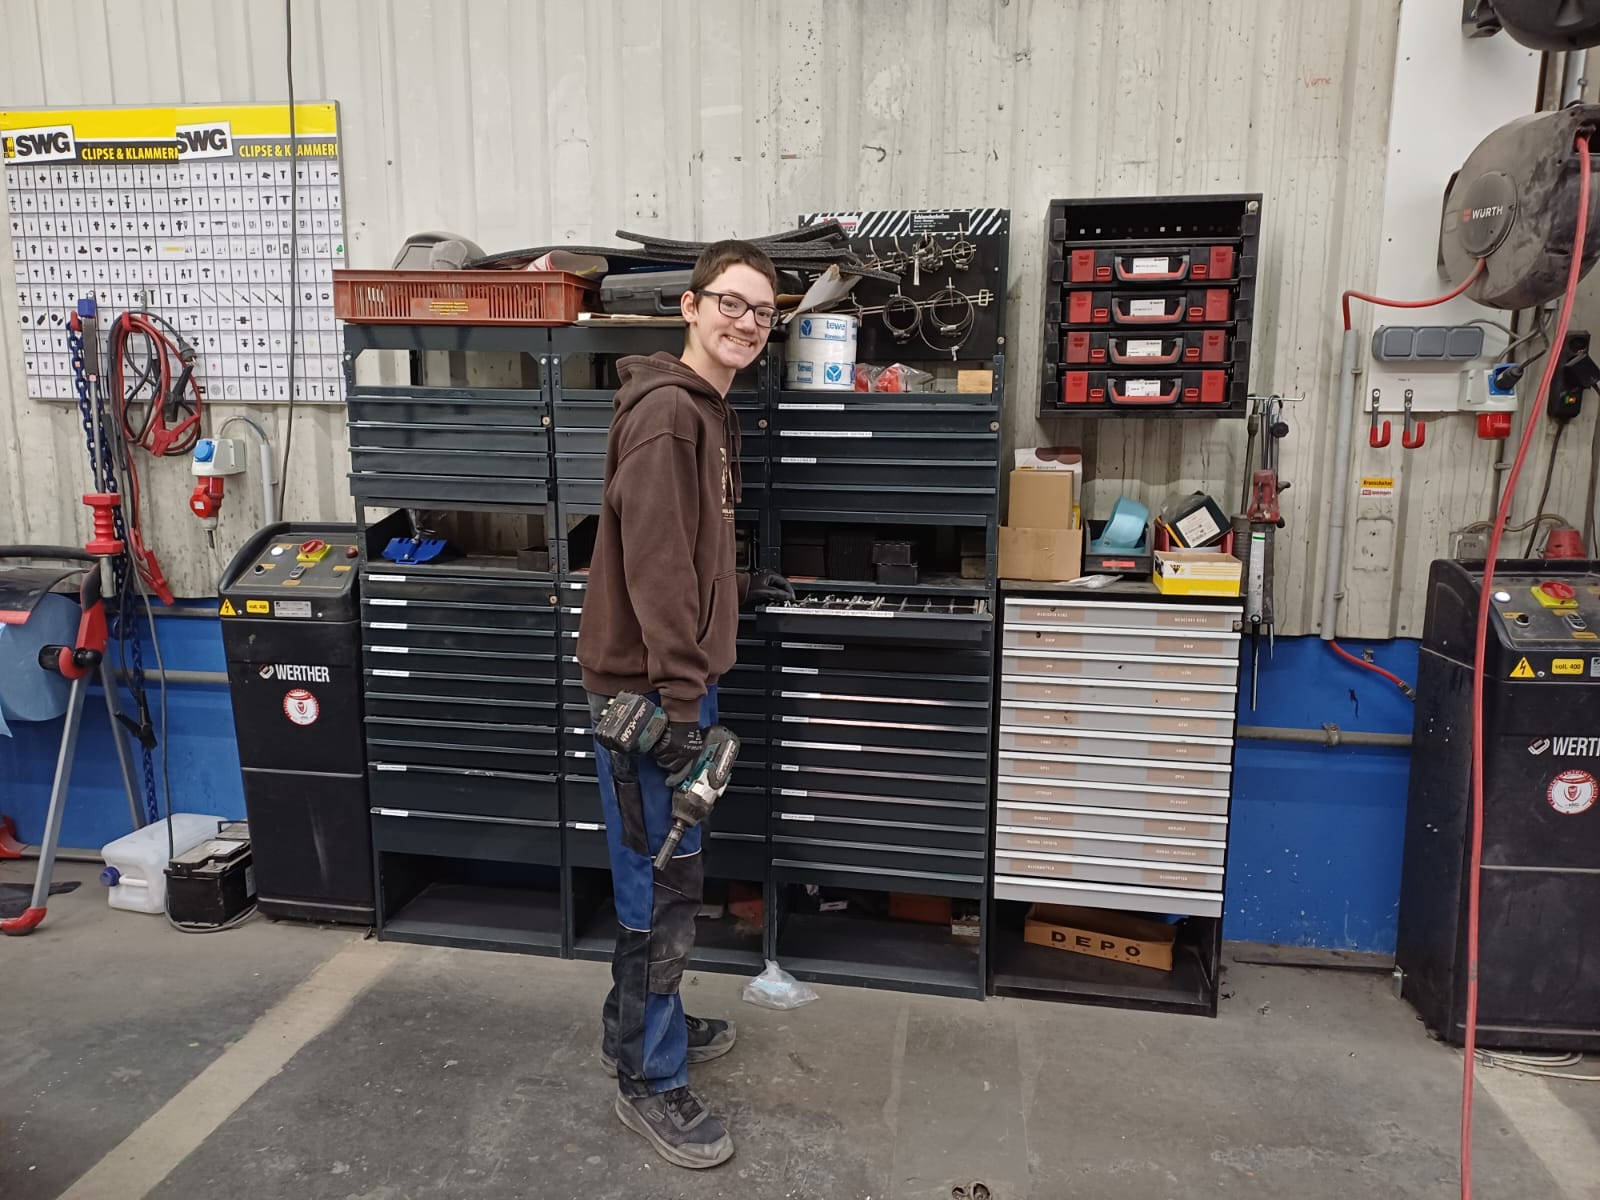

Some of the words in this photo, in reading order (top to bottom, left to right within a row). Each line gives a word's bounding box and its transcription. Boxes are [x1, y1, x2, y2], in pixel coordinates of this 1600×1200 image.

[16, 132, 71, 156] SWG
[81, 147, 116, 160] CLIPSE
[116, 148, 125, 160] &
[239, 144, 273, 158] CLIPSE
[275, 145, 284, 157] &
[285, 143, 338, 157] KAMMER
[275, 664, 330, 682] WERTHER
[1552, 736, 1600, 757] WERT
[1051, 930, 1141, 957] DEPO
